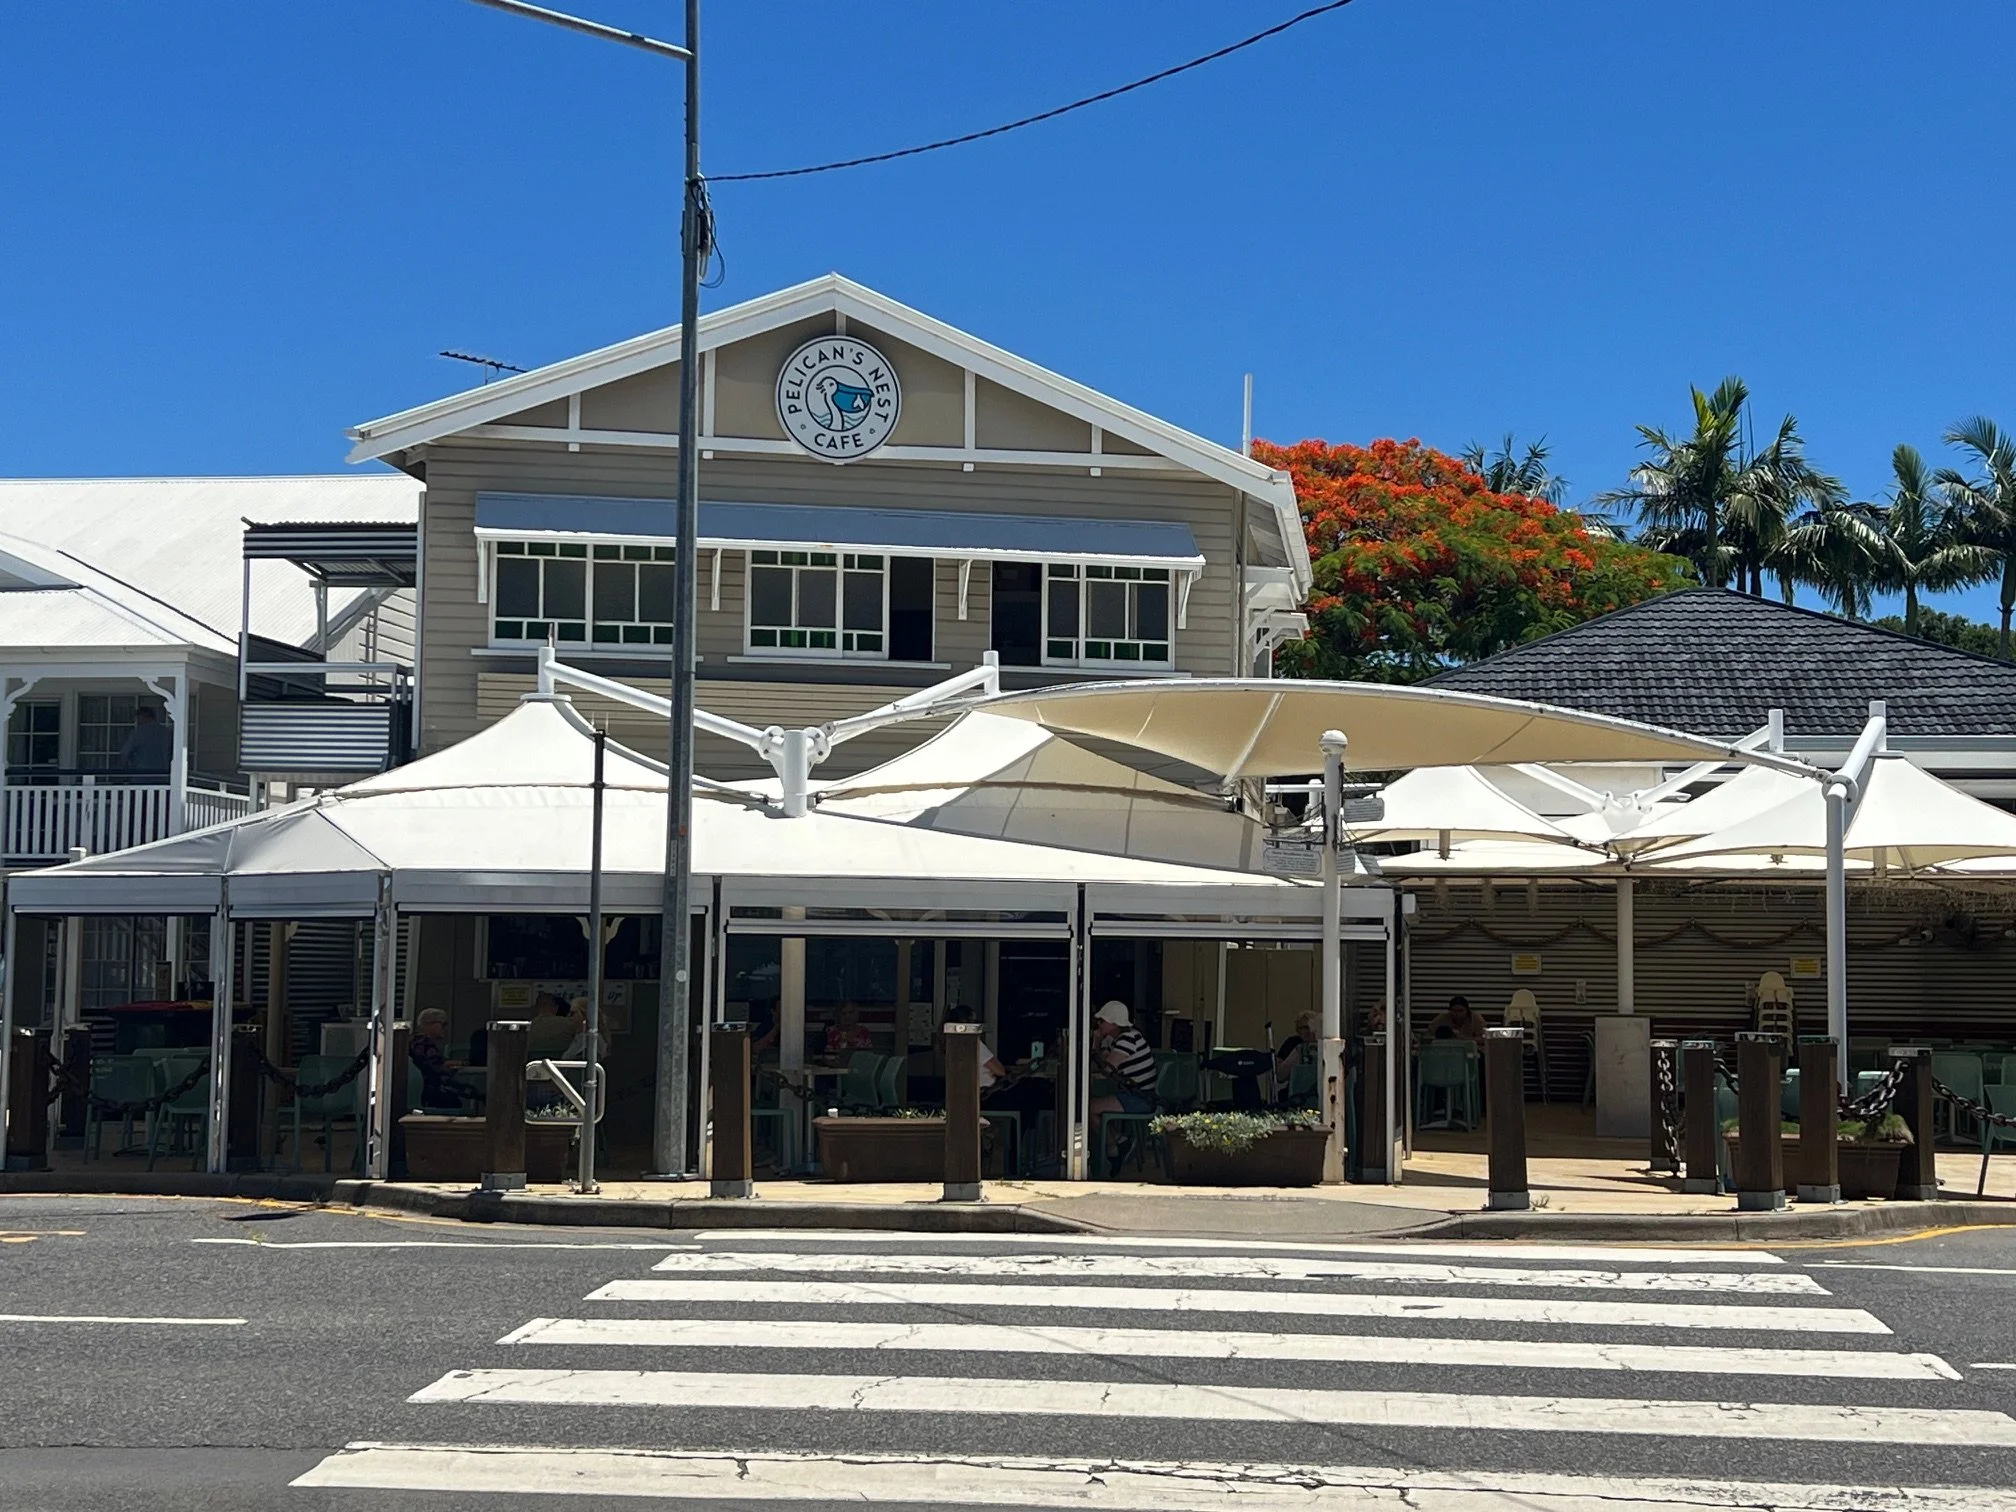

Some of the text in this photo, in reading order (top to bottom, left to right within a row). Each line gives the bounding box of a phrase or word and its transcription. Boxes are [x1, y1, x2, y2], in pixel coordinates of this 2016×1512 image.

[786, 346, 890, 422] PELICAN'S NEST
[814, 432, 864, 450] CAFE
